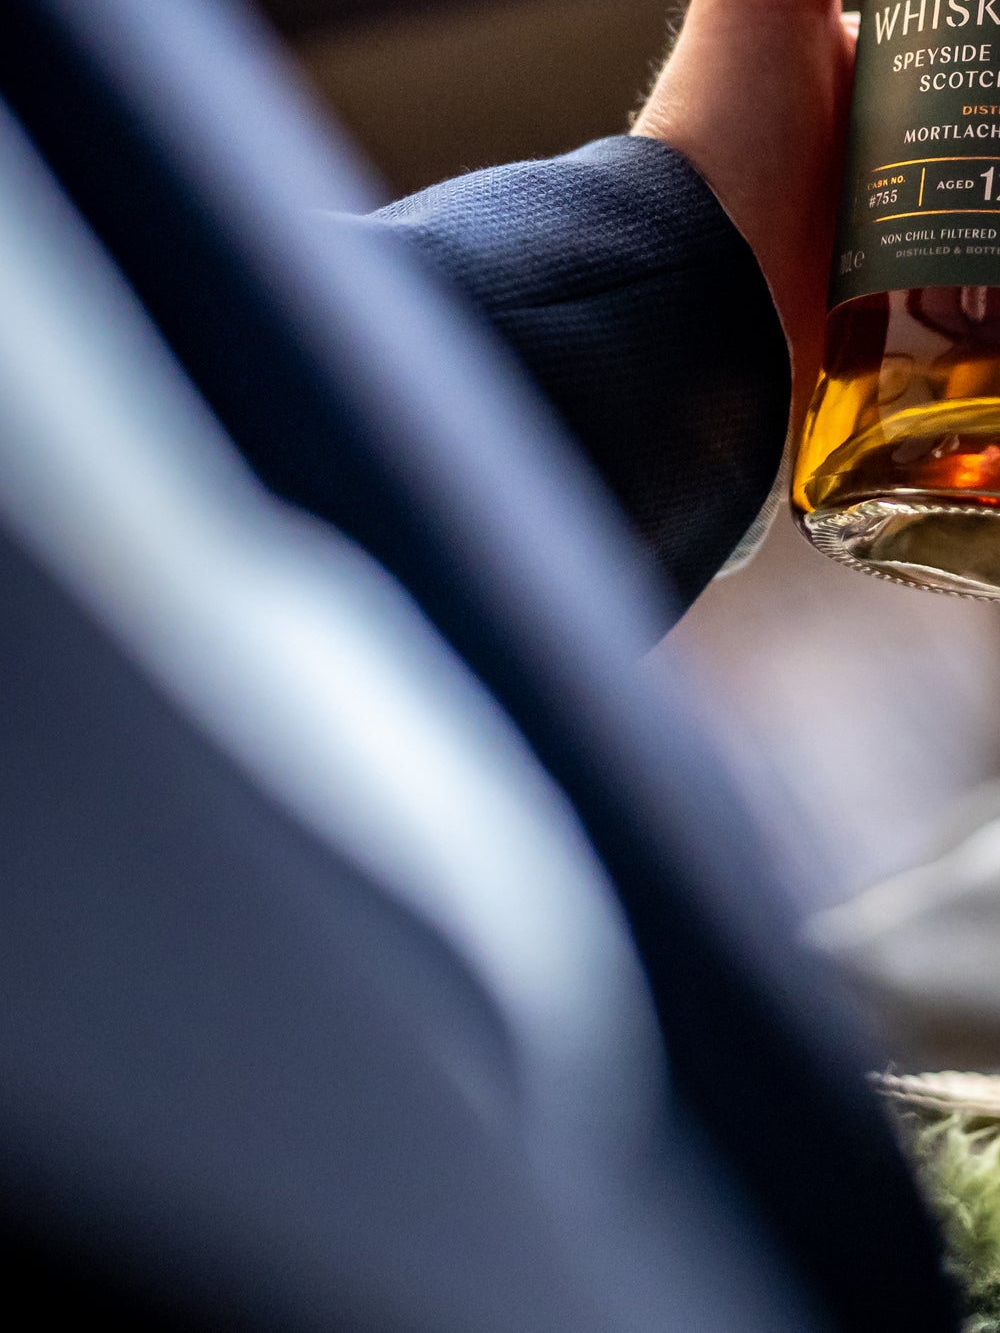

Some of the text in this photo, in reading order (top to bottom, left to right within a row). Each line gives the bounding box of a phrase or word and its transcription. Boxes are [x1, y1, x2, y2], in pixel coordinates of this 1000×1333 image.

[892, 43, 992, 73] SPEYSIDE
[936, 180, 975, 191] AGED
[869, 189, 898, 208] #755
[880, 233, 903, 246] NON
[905, 229, 937, 242] CHILL
[940, 228, 997, 240] FILTERED
[895, 246, 951, 259] DISTILLED
[954, 246, 961, 255] &
